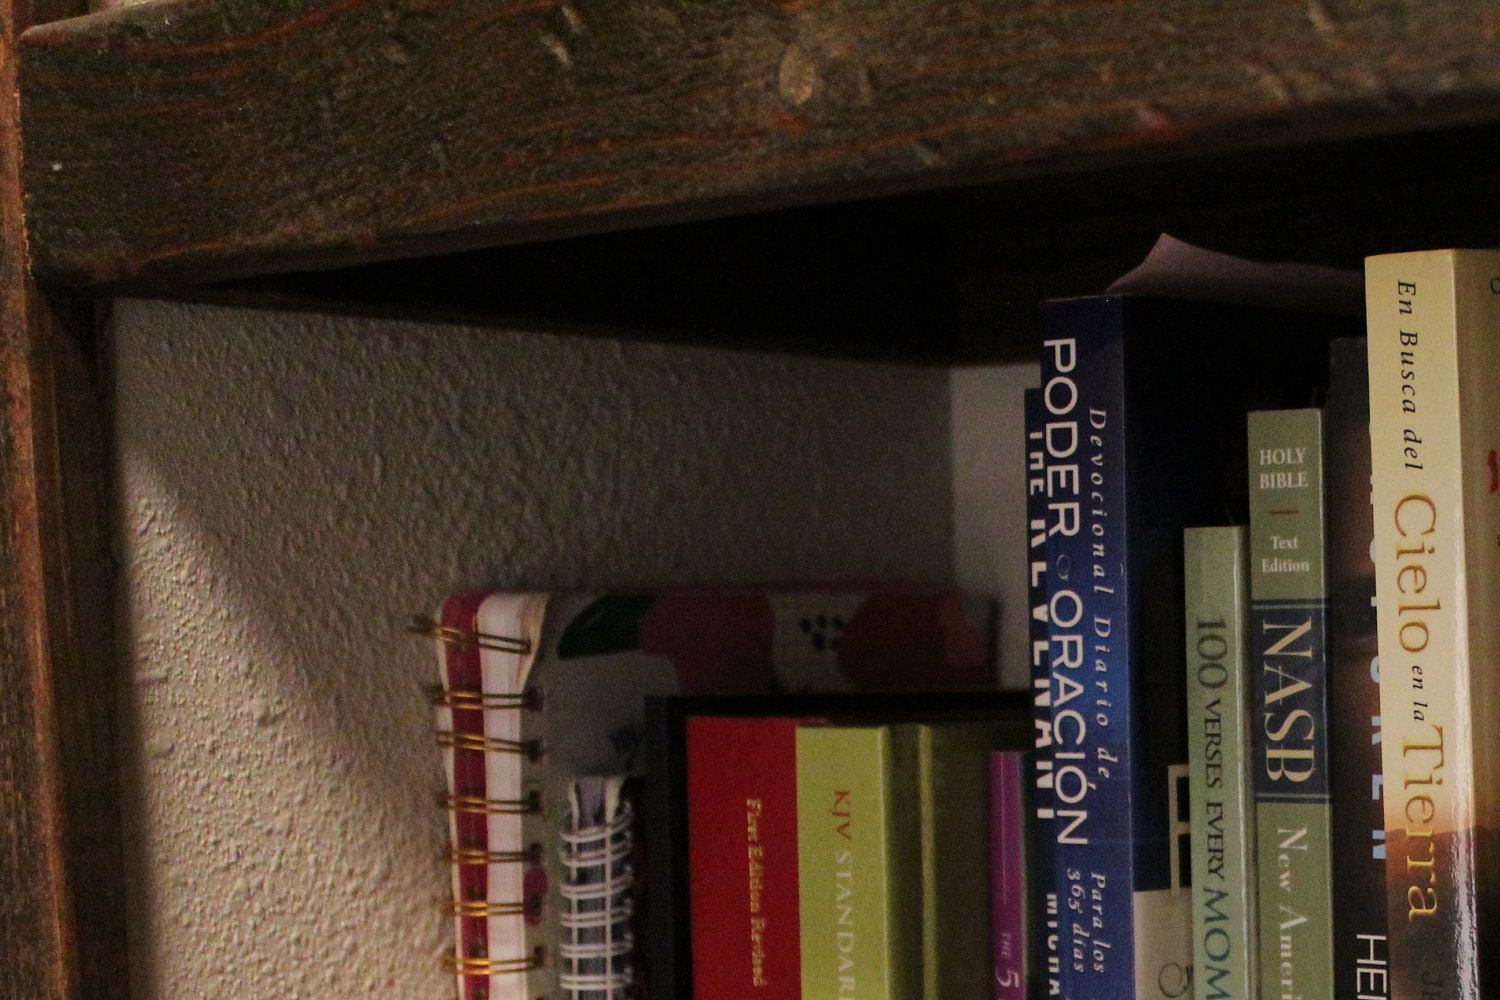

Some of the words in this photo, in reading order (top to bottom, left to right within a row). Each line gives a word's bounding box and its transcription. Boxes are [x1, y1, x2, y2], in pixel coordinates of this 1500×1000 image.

[1397, 280, 1417, 315] En
[1399, 330, 1418, 414] Busca
[1043, 338, 1080, 537] PODER
[1259, 447, 1307, 466] HOLY
[1403, 427, 1423, 471] del
[1089, 407, 1115, 594] Devocional
[1259, 471, 1309, 490] BIBLE
[1261, 558, 1310, 574] Edition
[1270, 535, 1299, 550] Text
[1394, 494, 1441, 653] Cielo
[1093, 616, 1112, 727] Diario
[1196, 618, 1229, 690] 100
[1411, 664, 1424, 690] en
[1050, 589, 1097, 844] ORACIÓN
[1262, 616, 1316, 783] NASB
[1413, 700, 1428, 722] la
[1097, 746, 1118, 779] de
[1203, 699, 1223, 790] VERSES
[834, 788, 852, 841] KJV
[1205, 802, 1226, 882] EVERY
[1402, 723, 1444, 923] Tierra
[748, 844, 764, 912] Edition
[1277, 827, 1308, 892] New
[1066, 867, 1086, 915] 365
[1091, 872, 1107, 929] Para
[751, 916, 768, 987] Revised
[996, 968, 1020, 989] 5
[1092, 939, 1111, 974] los
